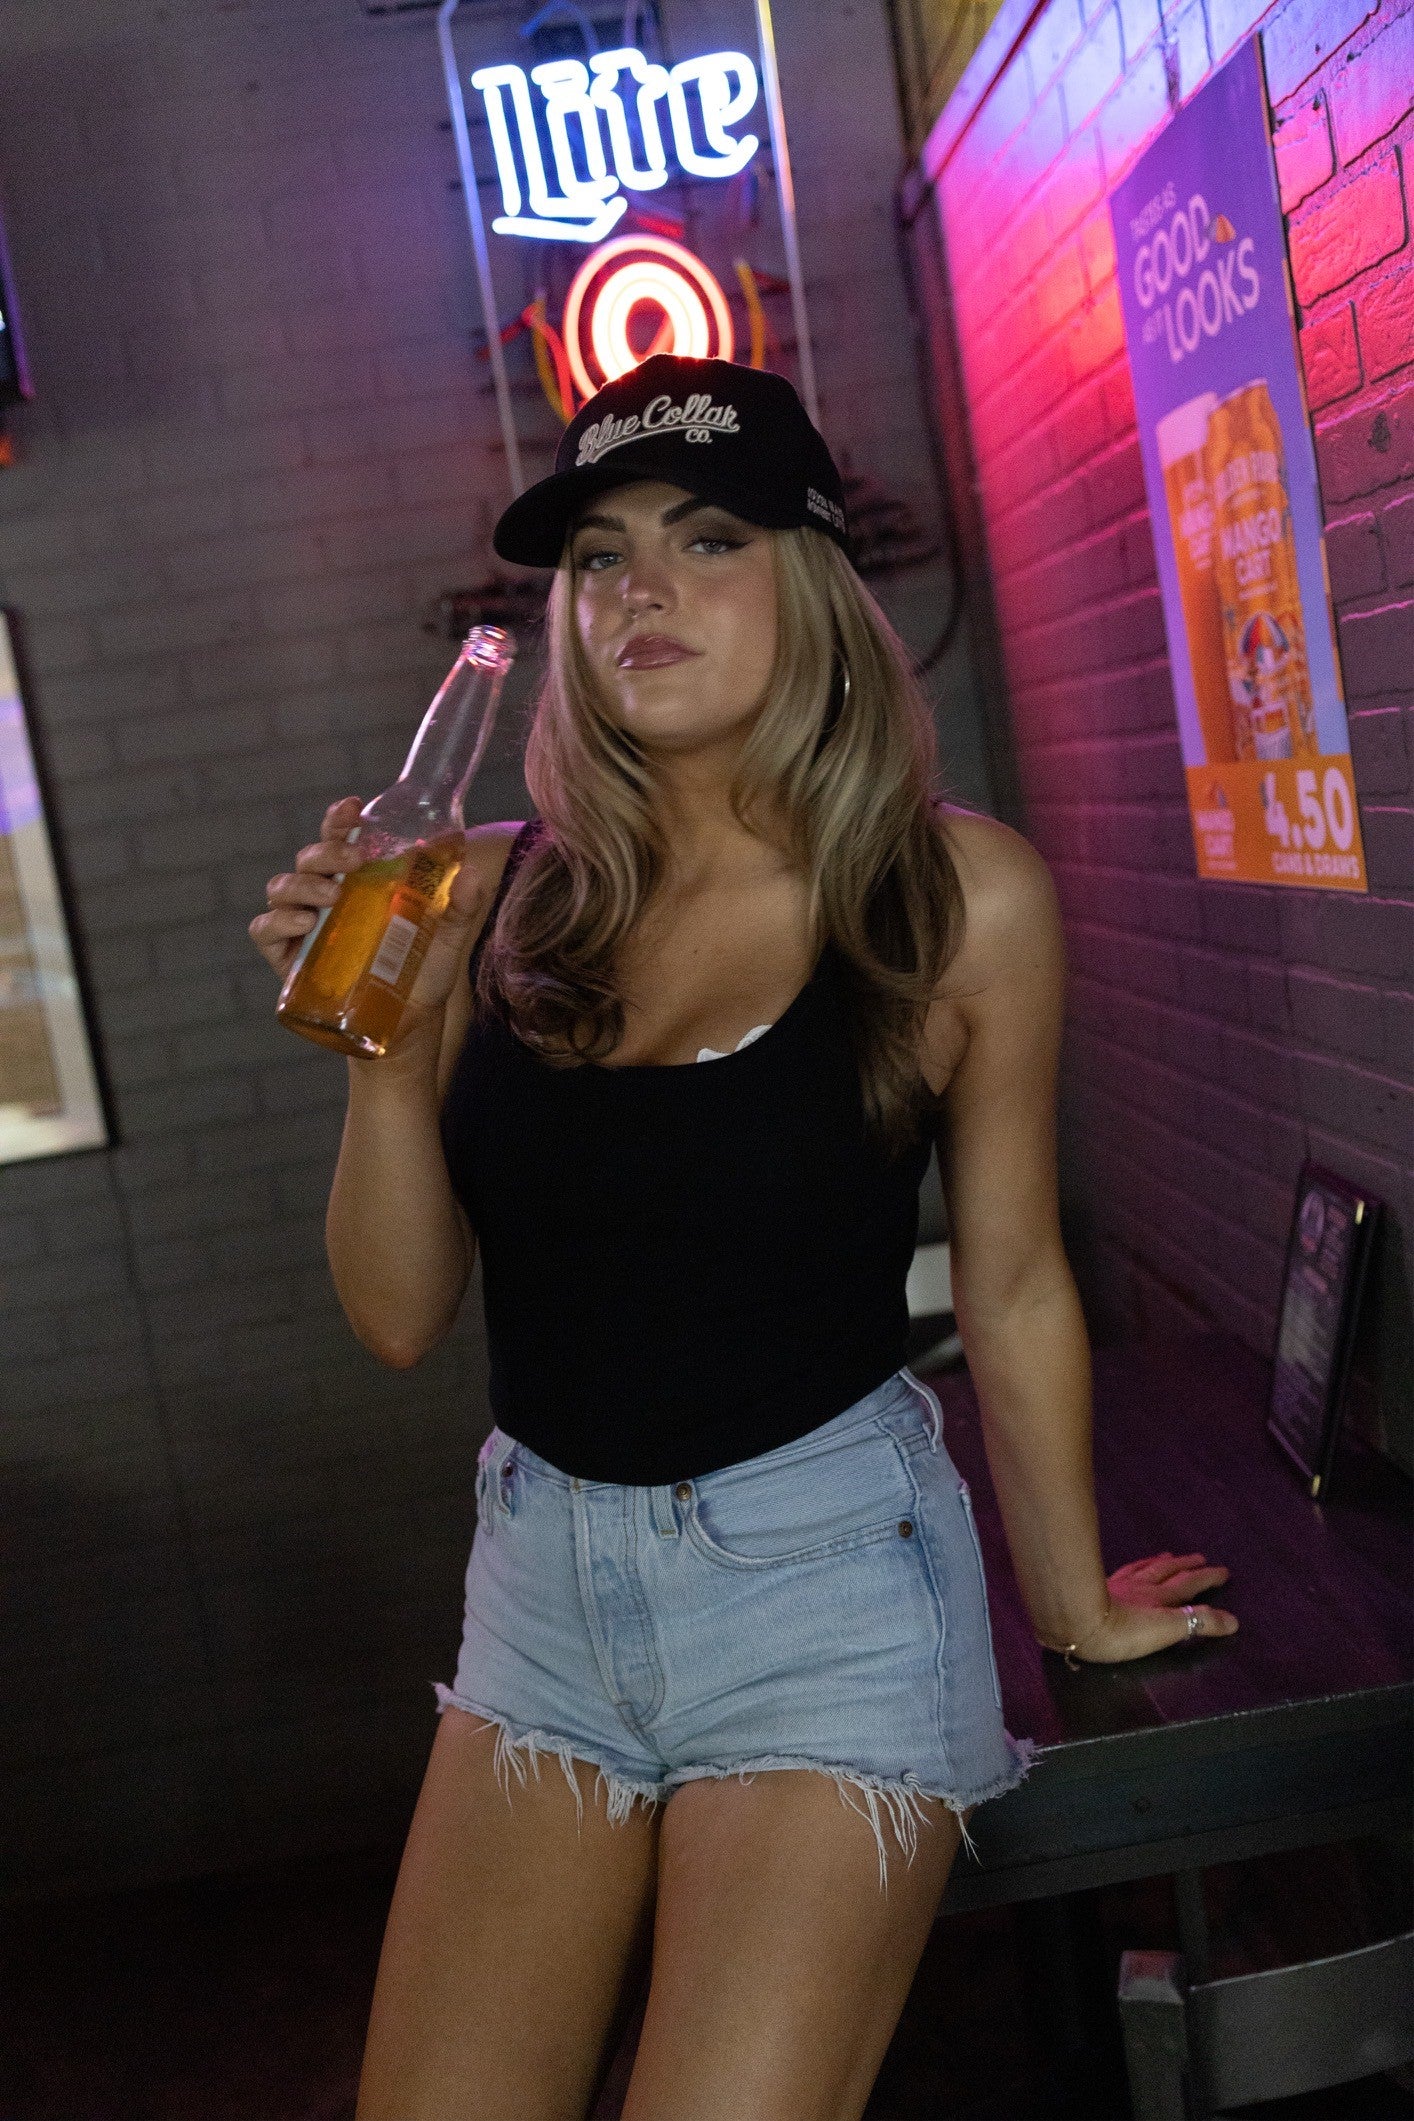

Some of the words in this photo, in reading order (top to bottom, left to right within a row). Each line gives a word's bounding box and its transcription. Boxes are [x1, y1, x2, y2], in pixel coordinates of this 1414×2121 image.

[470, 47, 759, 243] Lite
[1134, 193, 1211, 308] GOOD
[1162, 237, 1261, 363] LOOKS
[575, 412, 641, 467] Blue
[641, 393, 740, 434] Collar
[1220, 510, 1282, 560] MANGO
[1264, 767, 1355, 851] 4.50
